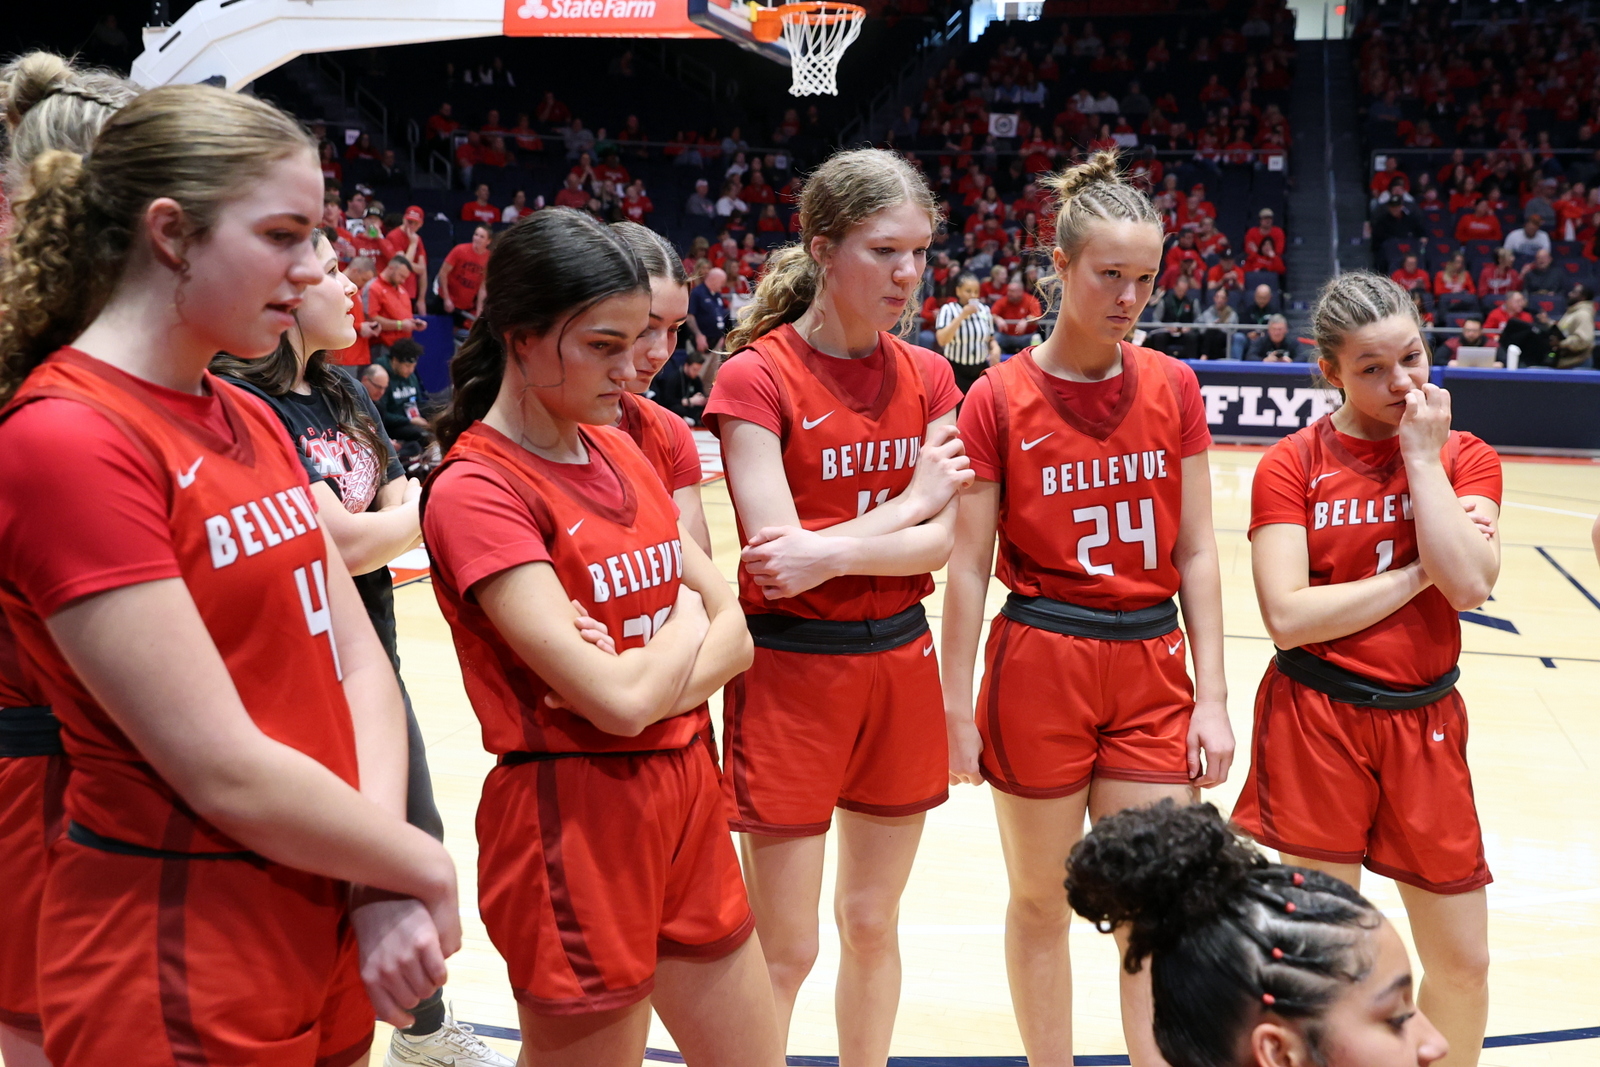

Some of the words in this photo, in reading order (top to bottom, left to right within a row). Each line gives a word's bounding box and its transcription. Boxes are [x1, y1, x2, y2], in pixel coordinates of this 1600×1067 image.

[1042, 450, 1167, 496] BELLEVUE
[1073, 498, 1157, 576] 24
[293, 560, 343, 681] 4
